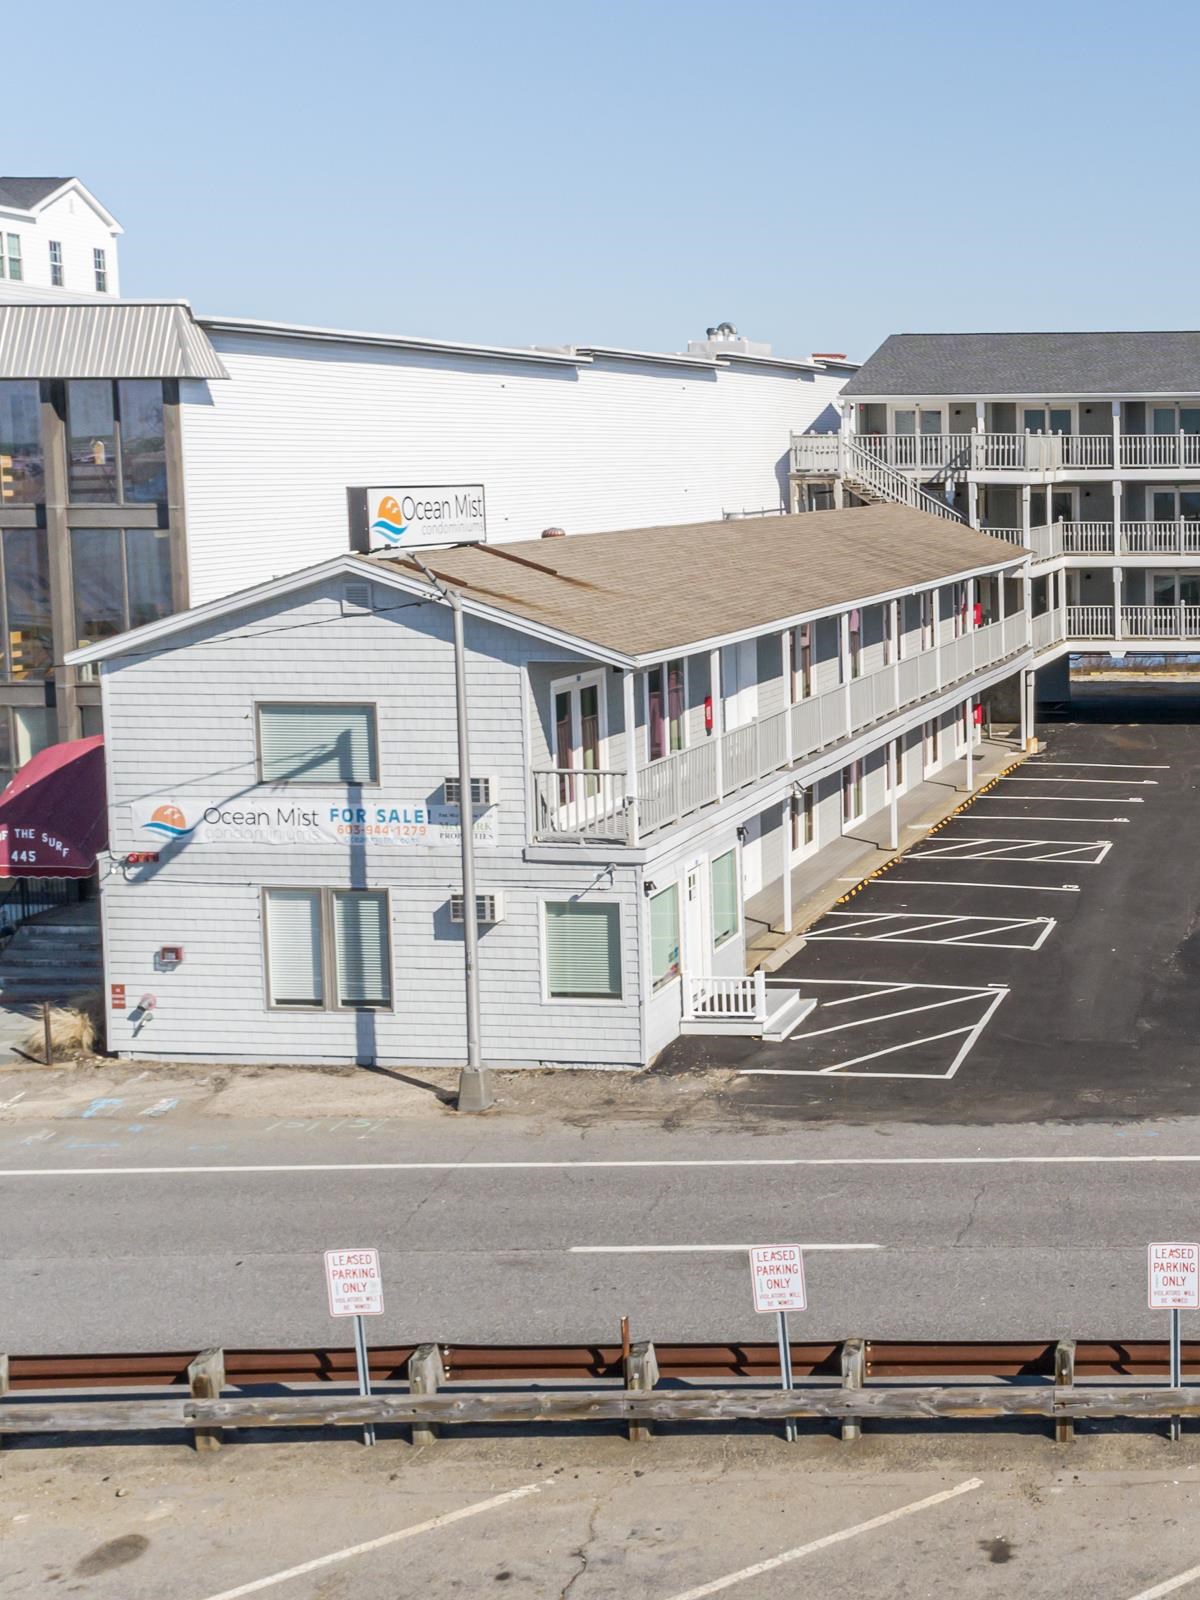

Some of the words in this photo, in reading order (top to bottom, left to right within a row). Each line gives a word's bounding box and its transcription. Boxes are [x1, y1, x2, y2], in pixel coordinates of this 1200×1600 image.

[402, 496, 451, 521] Ocean
[455, 494, 483, 518] Mist
[203, 807, 269, 825] Ocean
[277, 808, 319, 826] Mist
[330, 808, 366, 823] FOR
[377, 809, 432, 824] SALE!
[337, 824, 426, 836] 603-944-1279
[14, 828, 35, 839] THE
[41, 833, 70, 858] SURF
[11, 850, 36, 862] 445
[757, 1250, 795, 1262] LEASED
[1155, 1248, 1194, 1259] LEASED
[332, 1254, 372, 1266] LEASED
[332, 1268, 375, 1279] PARKING
[756, 1264, 798, 1276] PARKING
[1153, 1262, 1196, 1273] PARKING
[766, 1278, 790, 1289] ONLY
[1162, 1276, 1186, 1286] ONLY
[342, 1282, 367, 1293] ONLY
